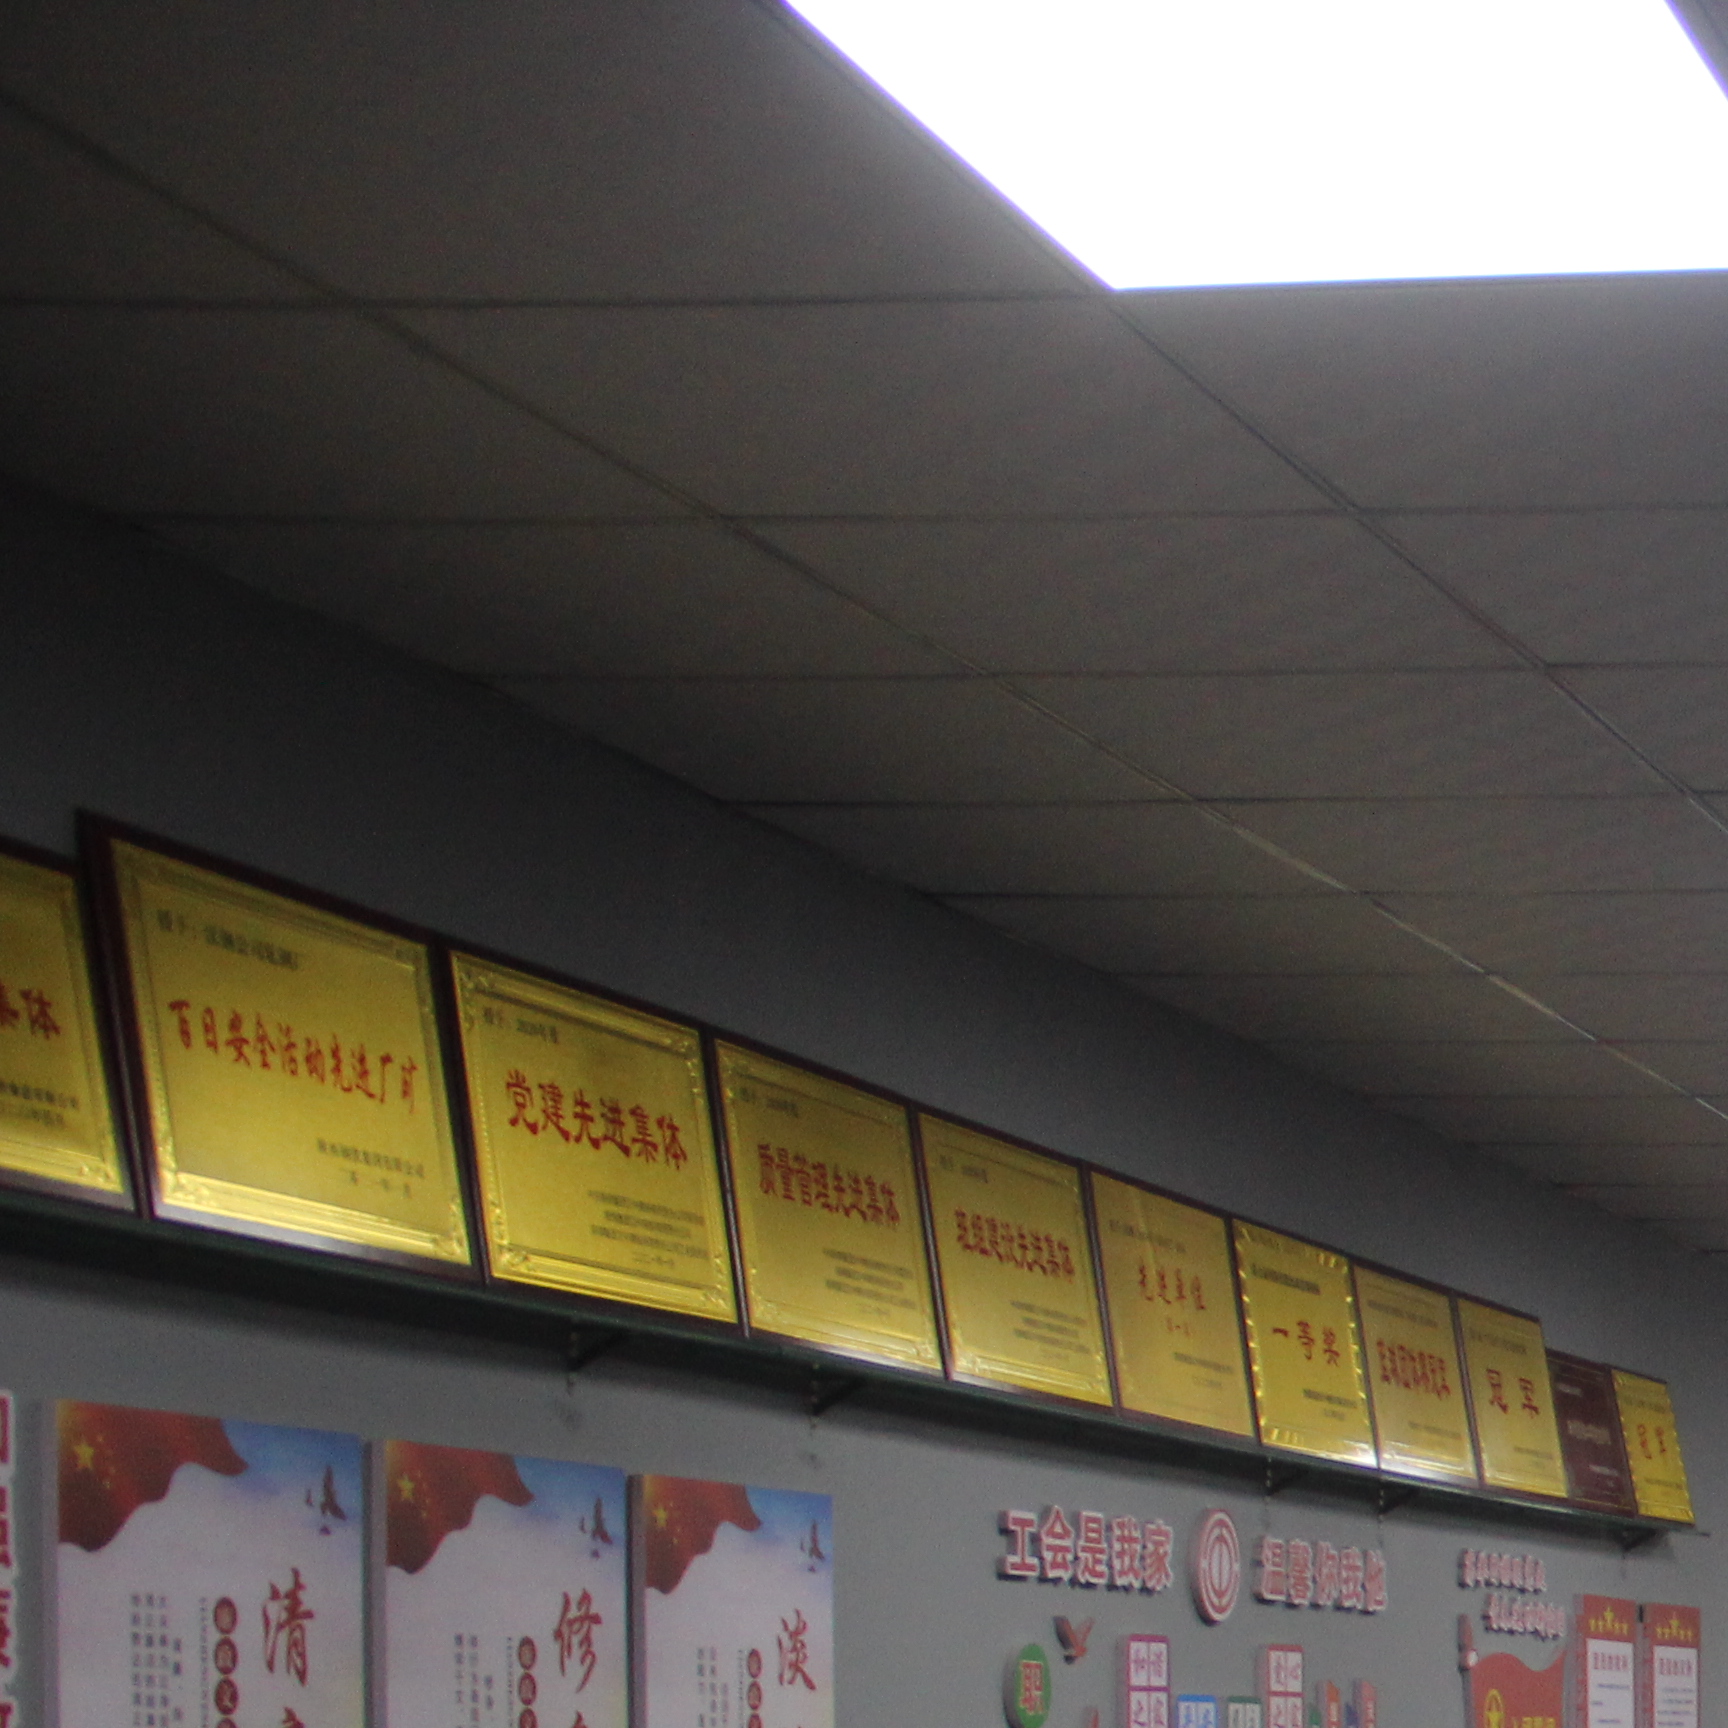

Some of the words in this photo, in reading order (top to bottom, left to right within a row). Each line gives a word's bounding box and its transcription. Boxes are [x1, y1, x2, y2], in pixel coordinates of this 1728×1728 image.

[505, 1069, 688, 1171] 党建先进集体
[1004, 1507, 1174, 1590] 工会是我家
[1260, 1535, 1388, 1612] 温馨你我他
